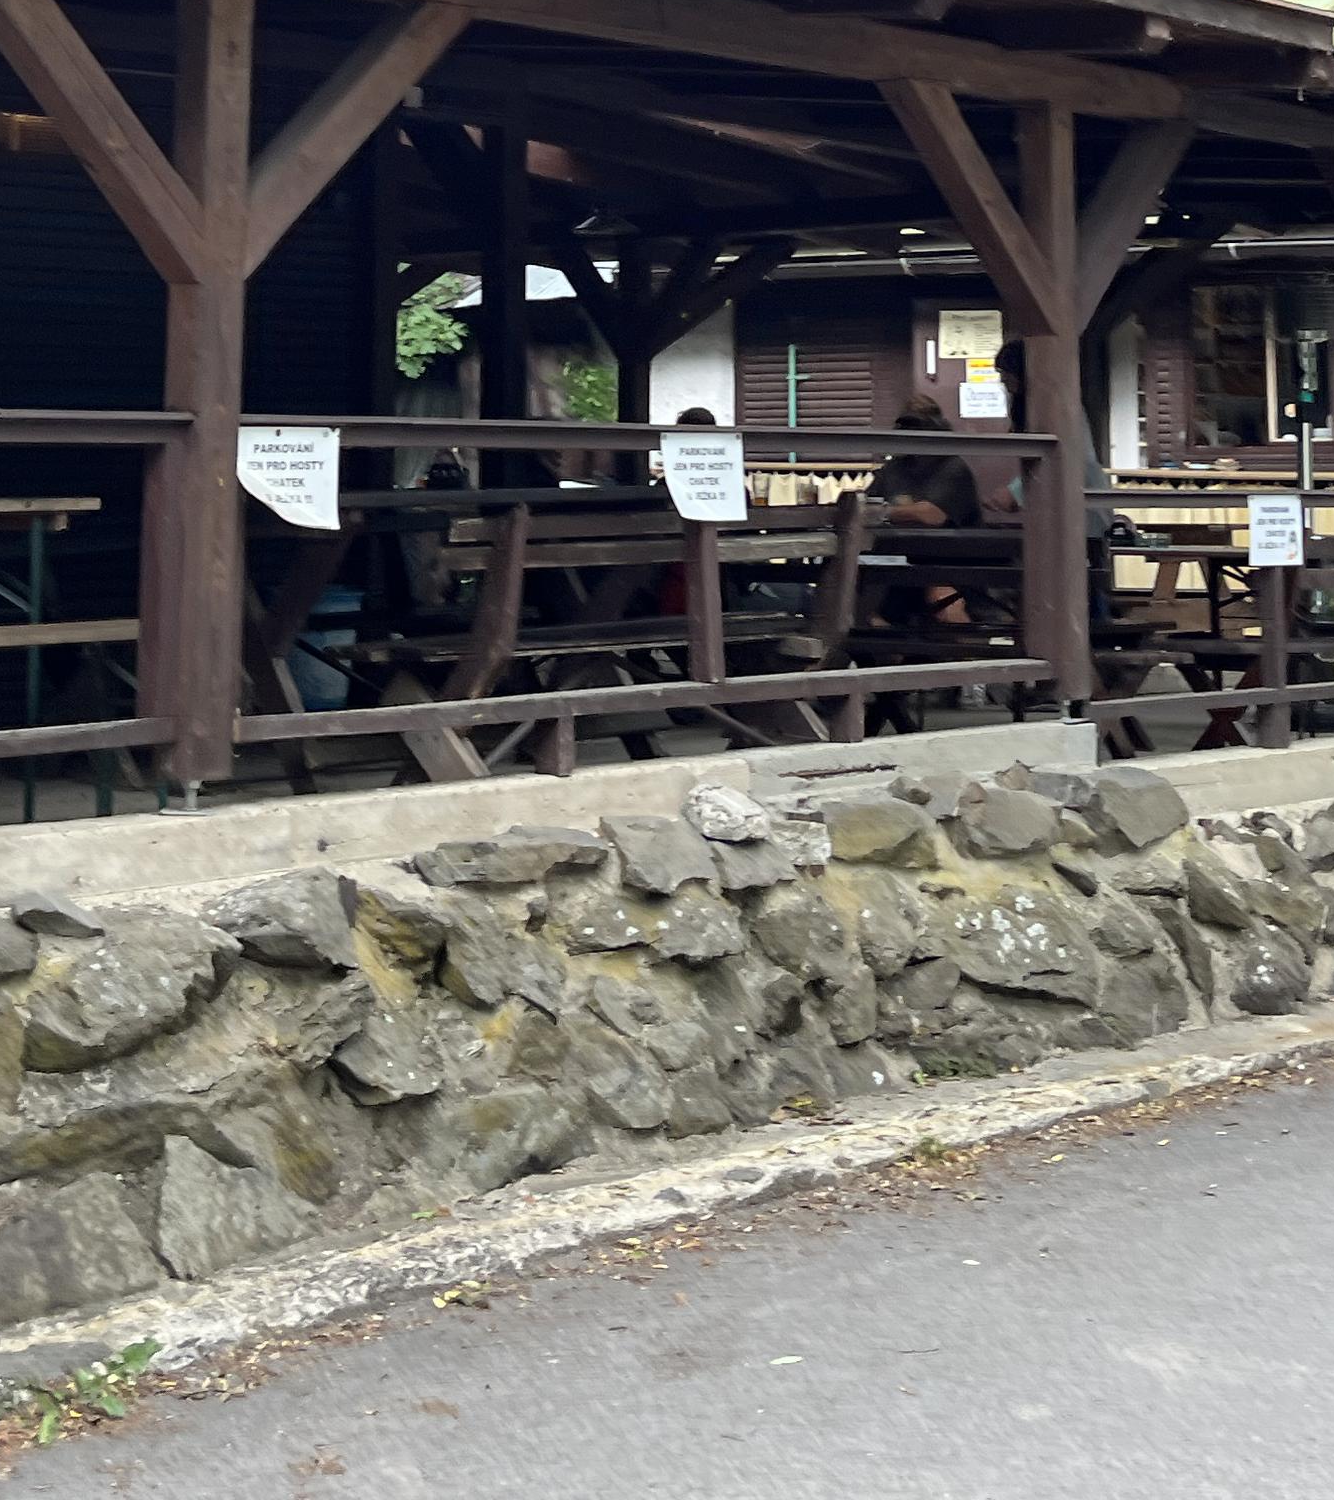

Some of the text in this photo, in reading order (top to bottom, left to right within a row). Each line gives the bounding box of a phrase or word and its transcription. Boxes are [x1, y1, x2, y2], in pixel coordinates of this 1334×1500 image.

[266, 461, 287, 471] PRO
[289, 460, 325, 471] HOSTY
[690, 461, 706, 471] PRO
